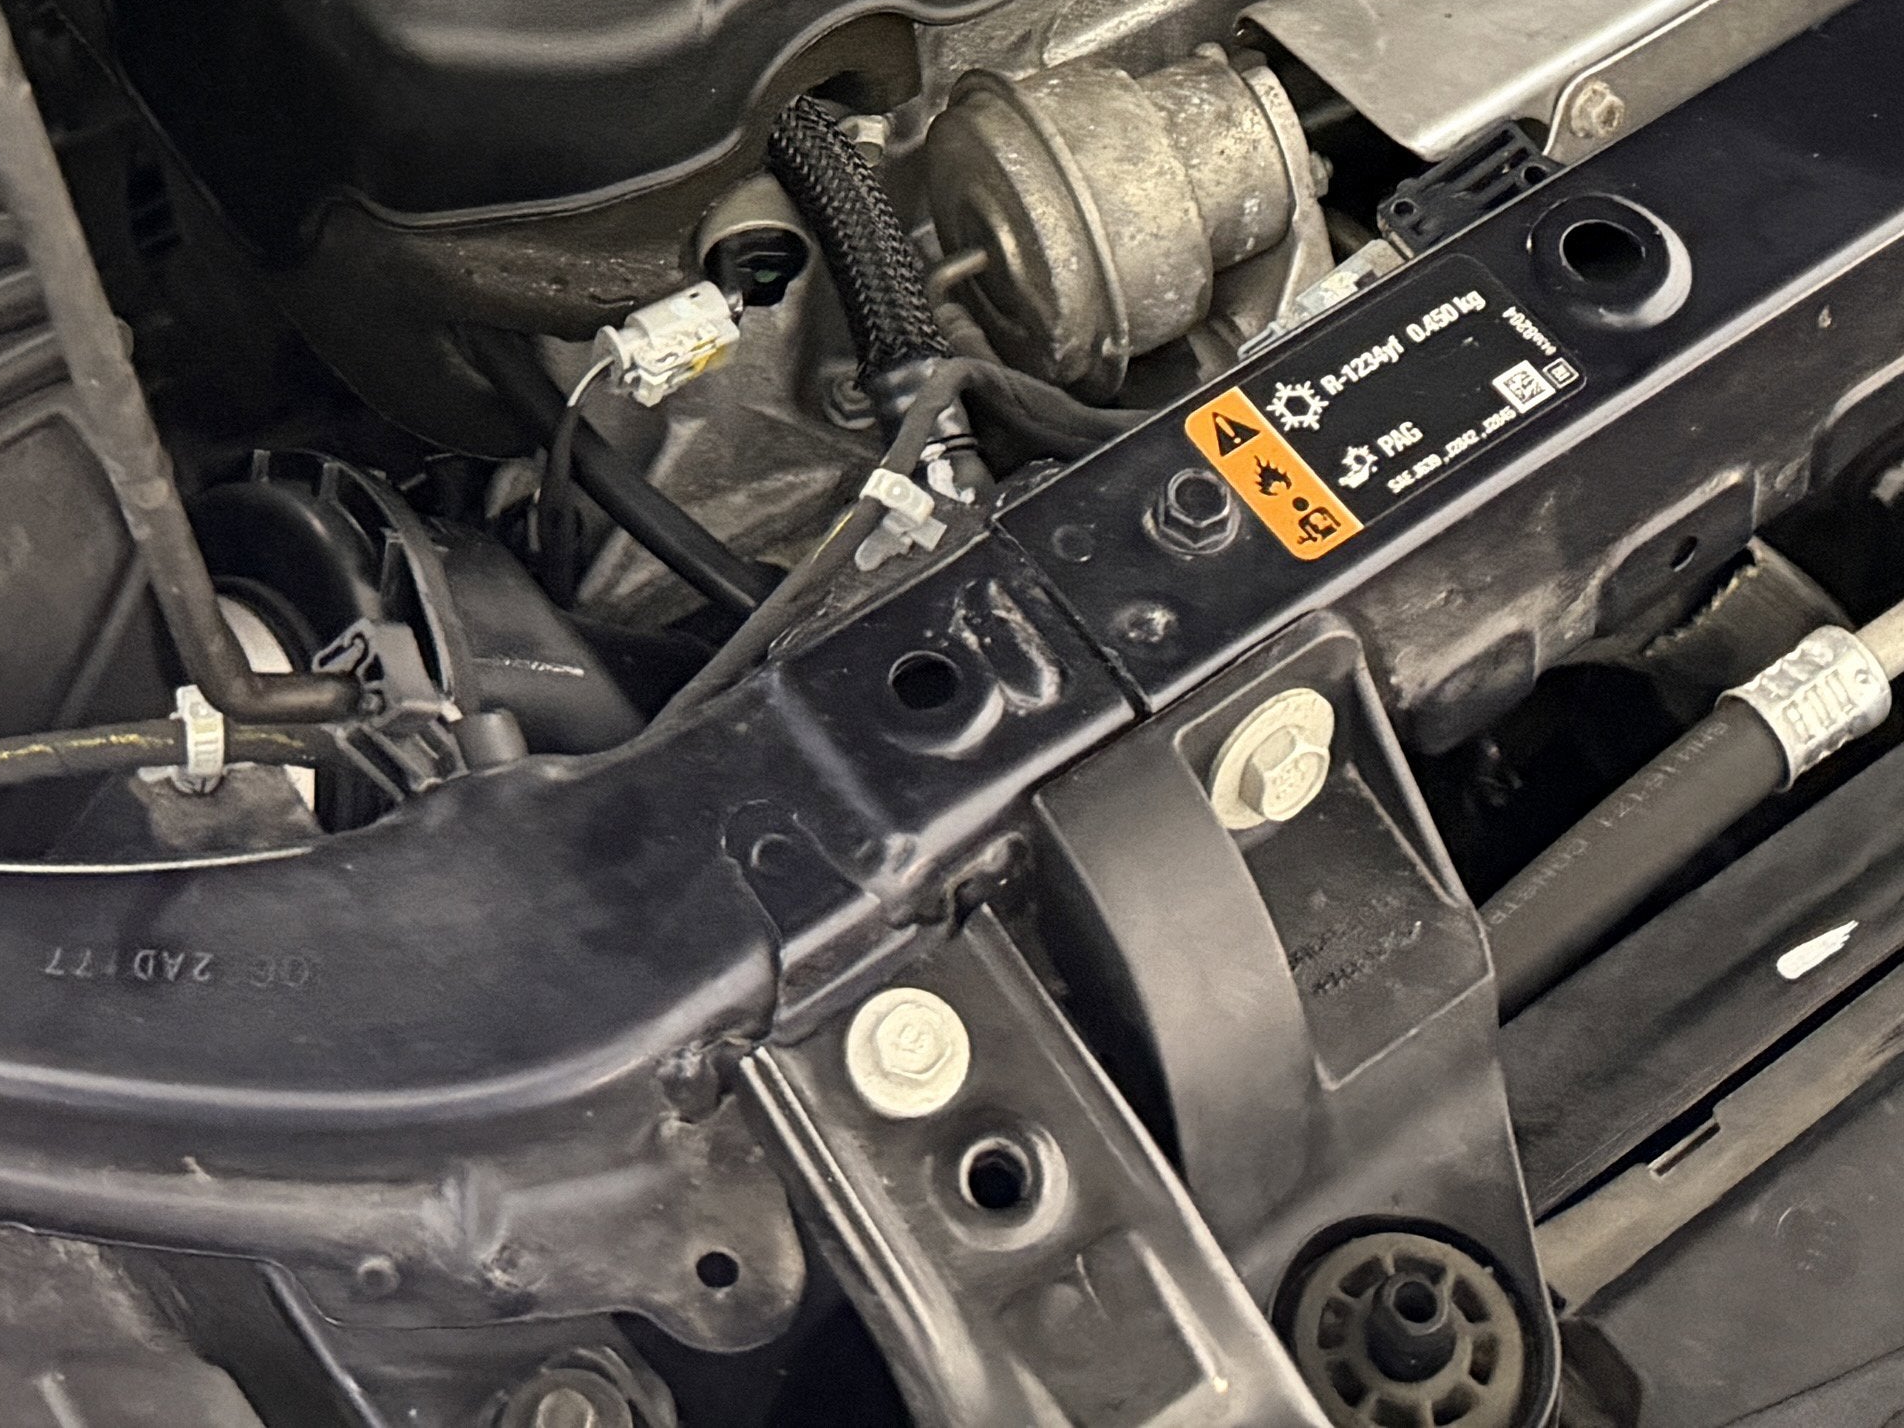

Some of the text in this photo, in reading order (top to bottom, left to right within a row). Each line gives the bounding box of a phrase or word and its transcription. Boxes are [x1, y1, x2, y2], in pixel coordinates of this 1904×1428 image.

[1320, 290, 1487, 396] R-1234yf 0.450 kg
[1377, 421, 1424, 457] PAG
